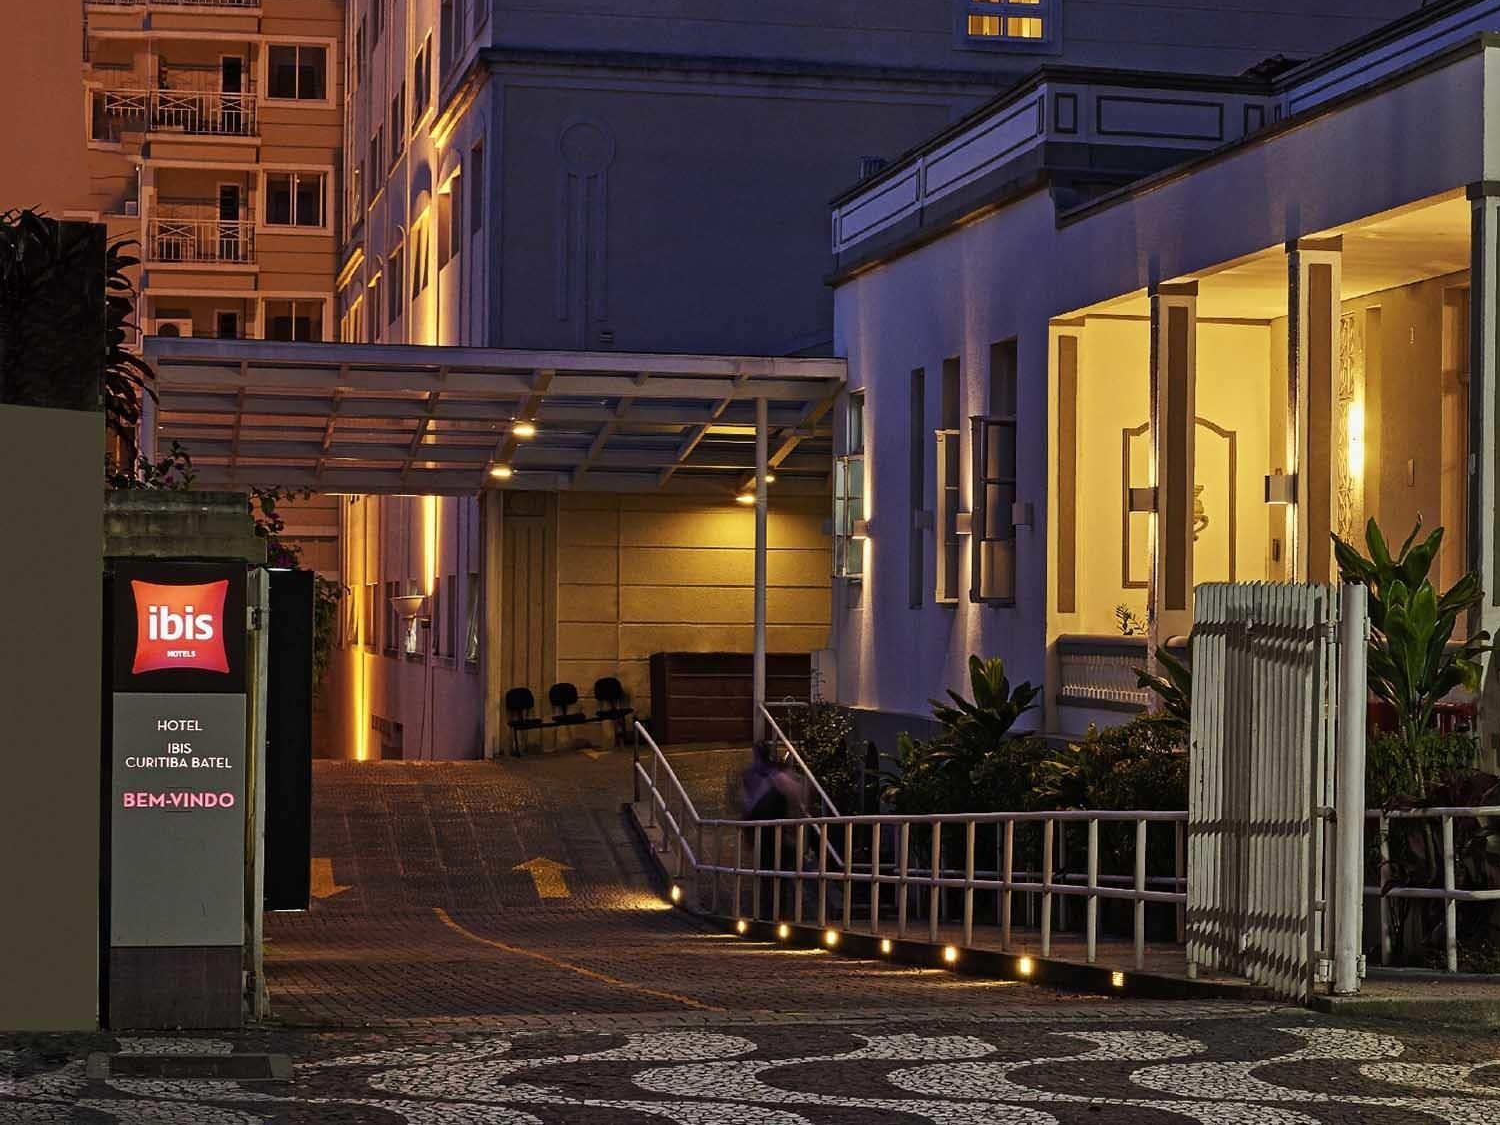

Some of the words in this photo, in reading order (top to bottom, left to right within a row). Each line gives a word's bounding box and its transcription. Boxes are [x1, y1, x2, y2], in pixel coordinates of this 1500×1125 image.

[148, 605, 214, 640] ibis
[166, 650, 197, 658] HOTELS
[157, 720, 203, 731] HOTEL
[167, 743, 193, 754] IBIS
[125, 757, 189, 768] CURITIBA
[191, 757, 233, 769] BATEL
[123, 792, 235, 808] BEM-VINDO
